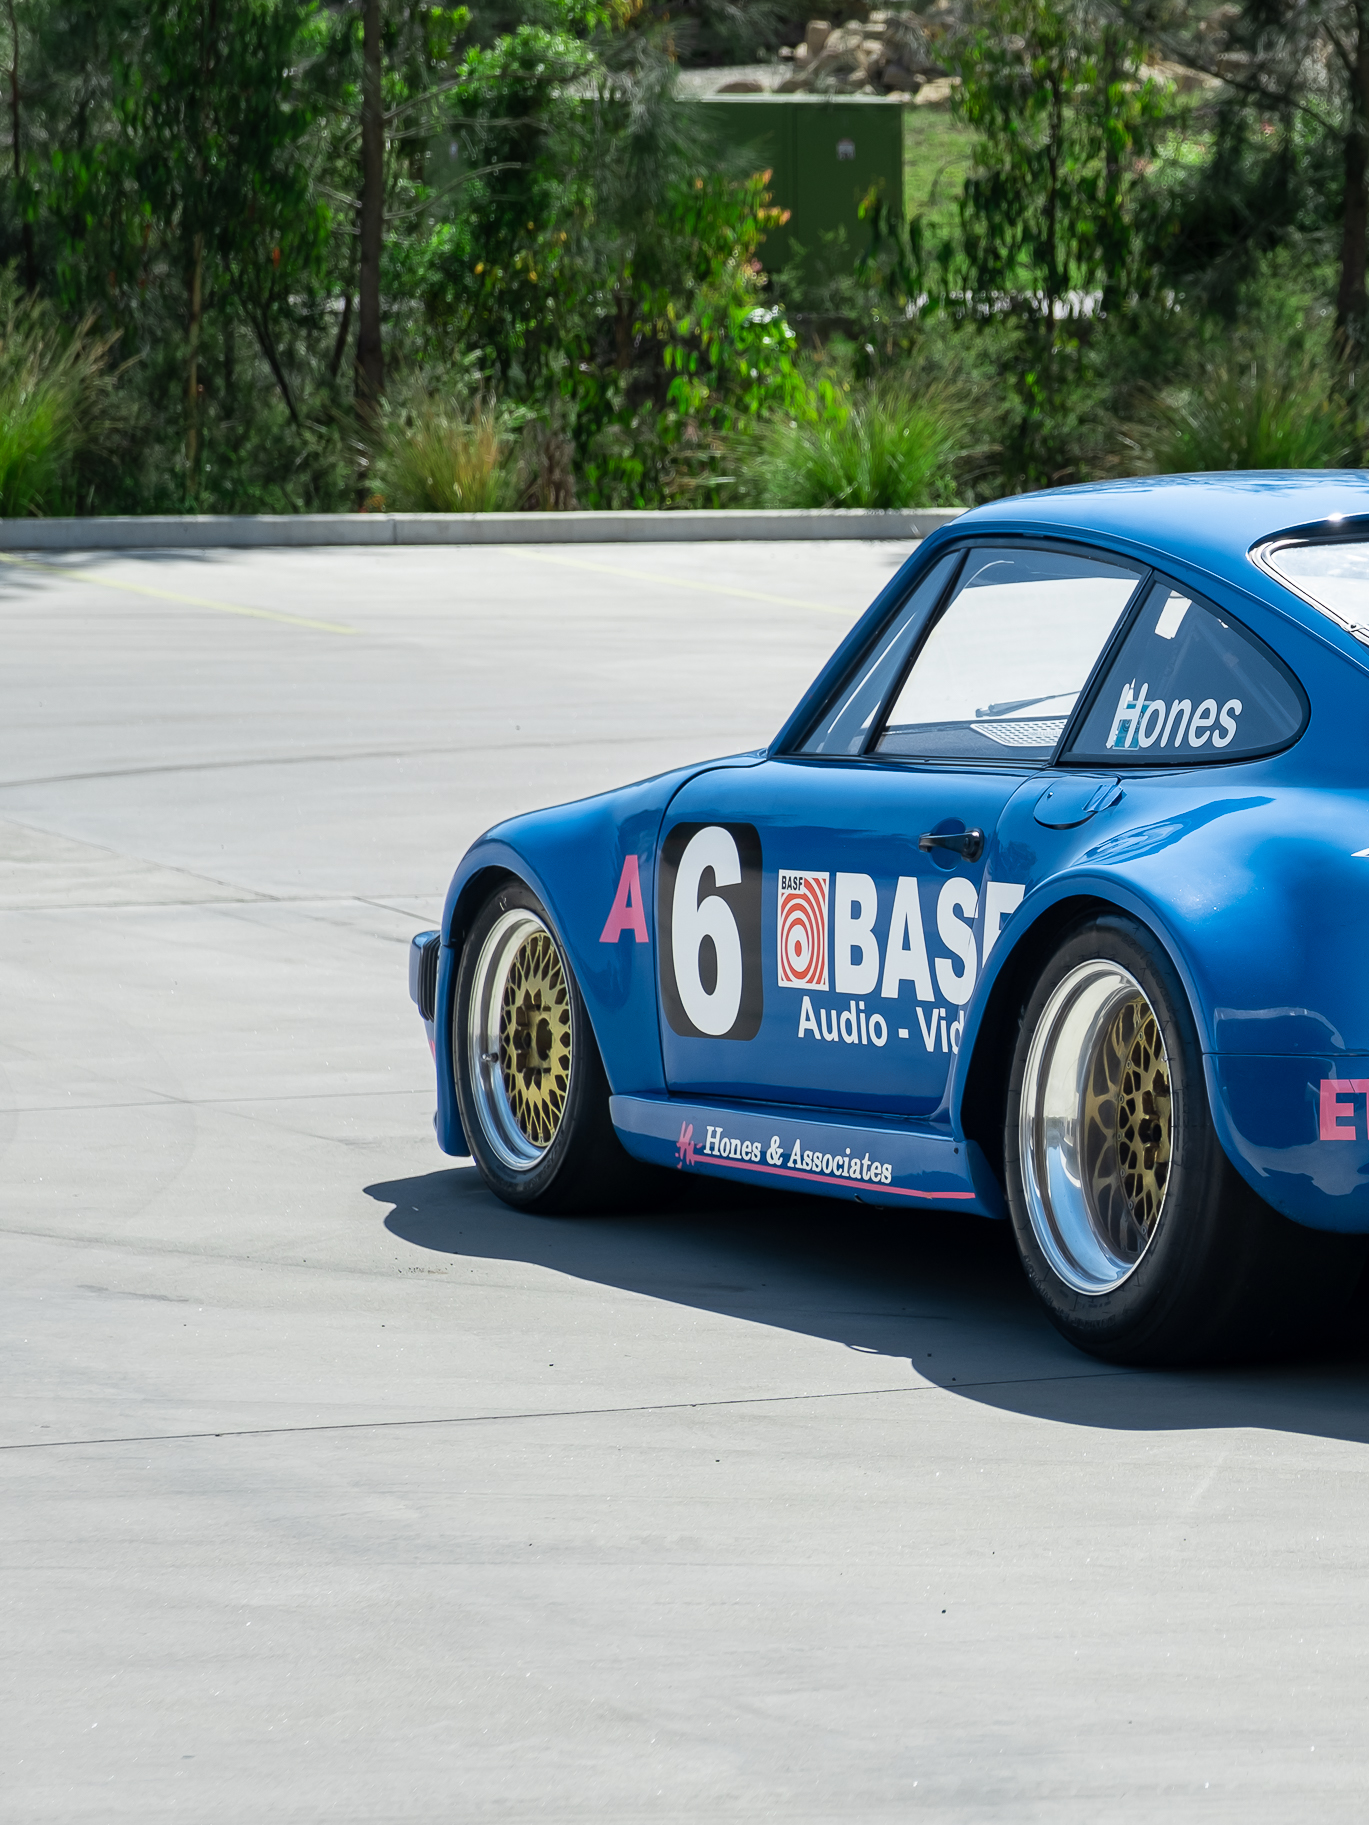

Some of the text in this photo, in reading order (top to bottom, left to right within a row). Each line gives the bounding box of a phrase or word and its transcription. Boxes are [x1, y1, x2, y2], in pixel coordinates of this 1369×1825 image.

[1106, 682, 1243, 749] Hones
[600, 855, 649, 943] A
[781, 875, 803, 891] BASF
[671, 826, 743, 1036] 6
[835, 872, 1025, 1006] BASF
[798, 996, 888, 1047] Audio
[704, 1125, 892, 1184] Hones & Associates
